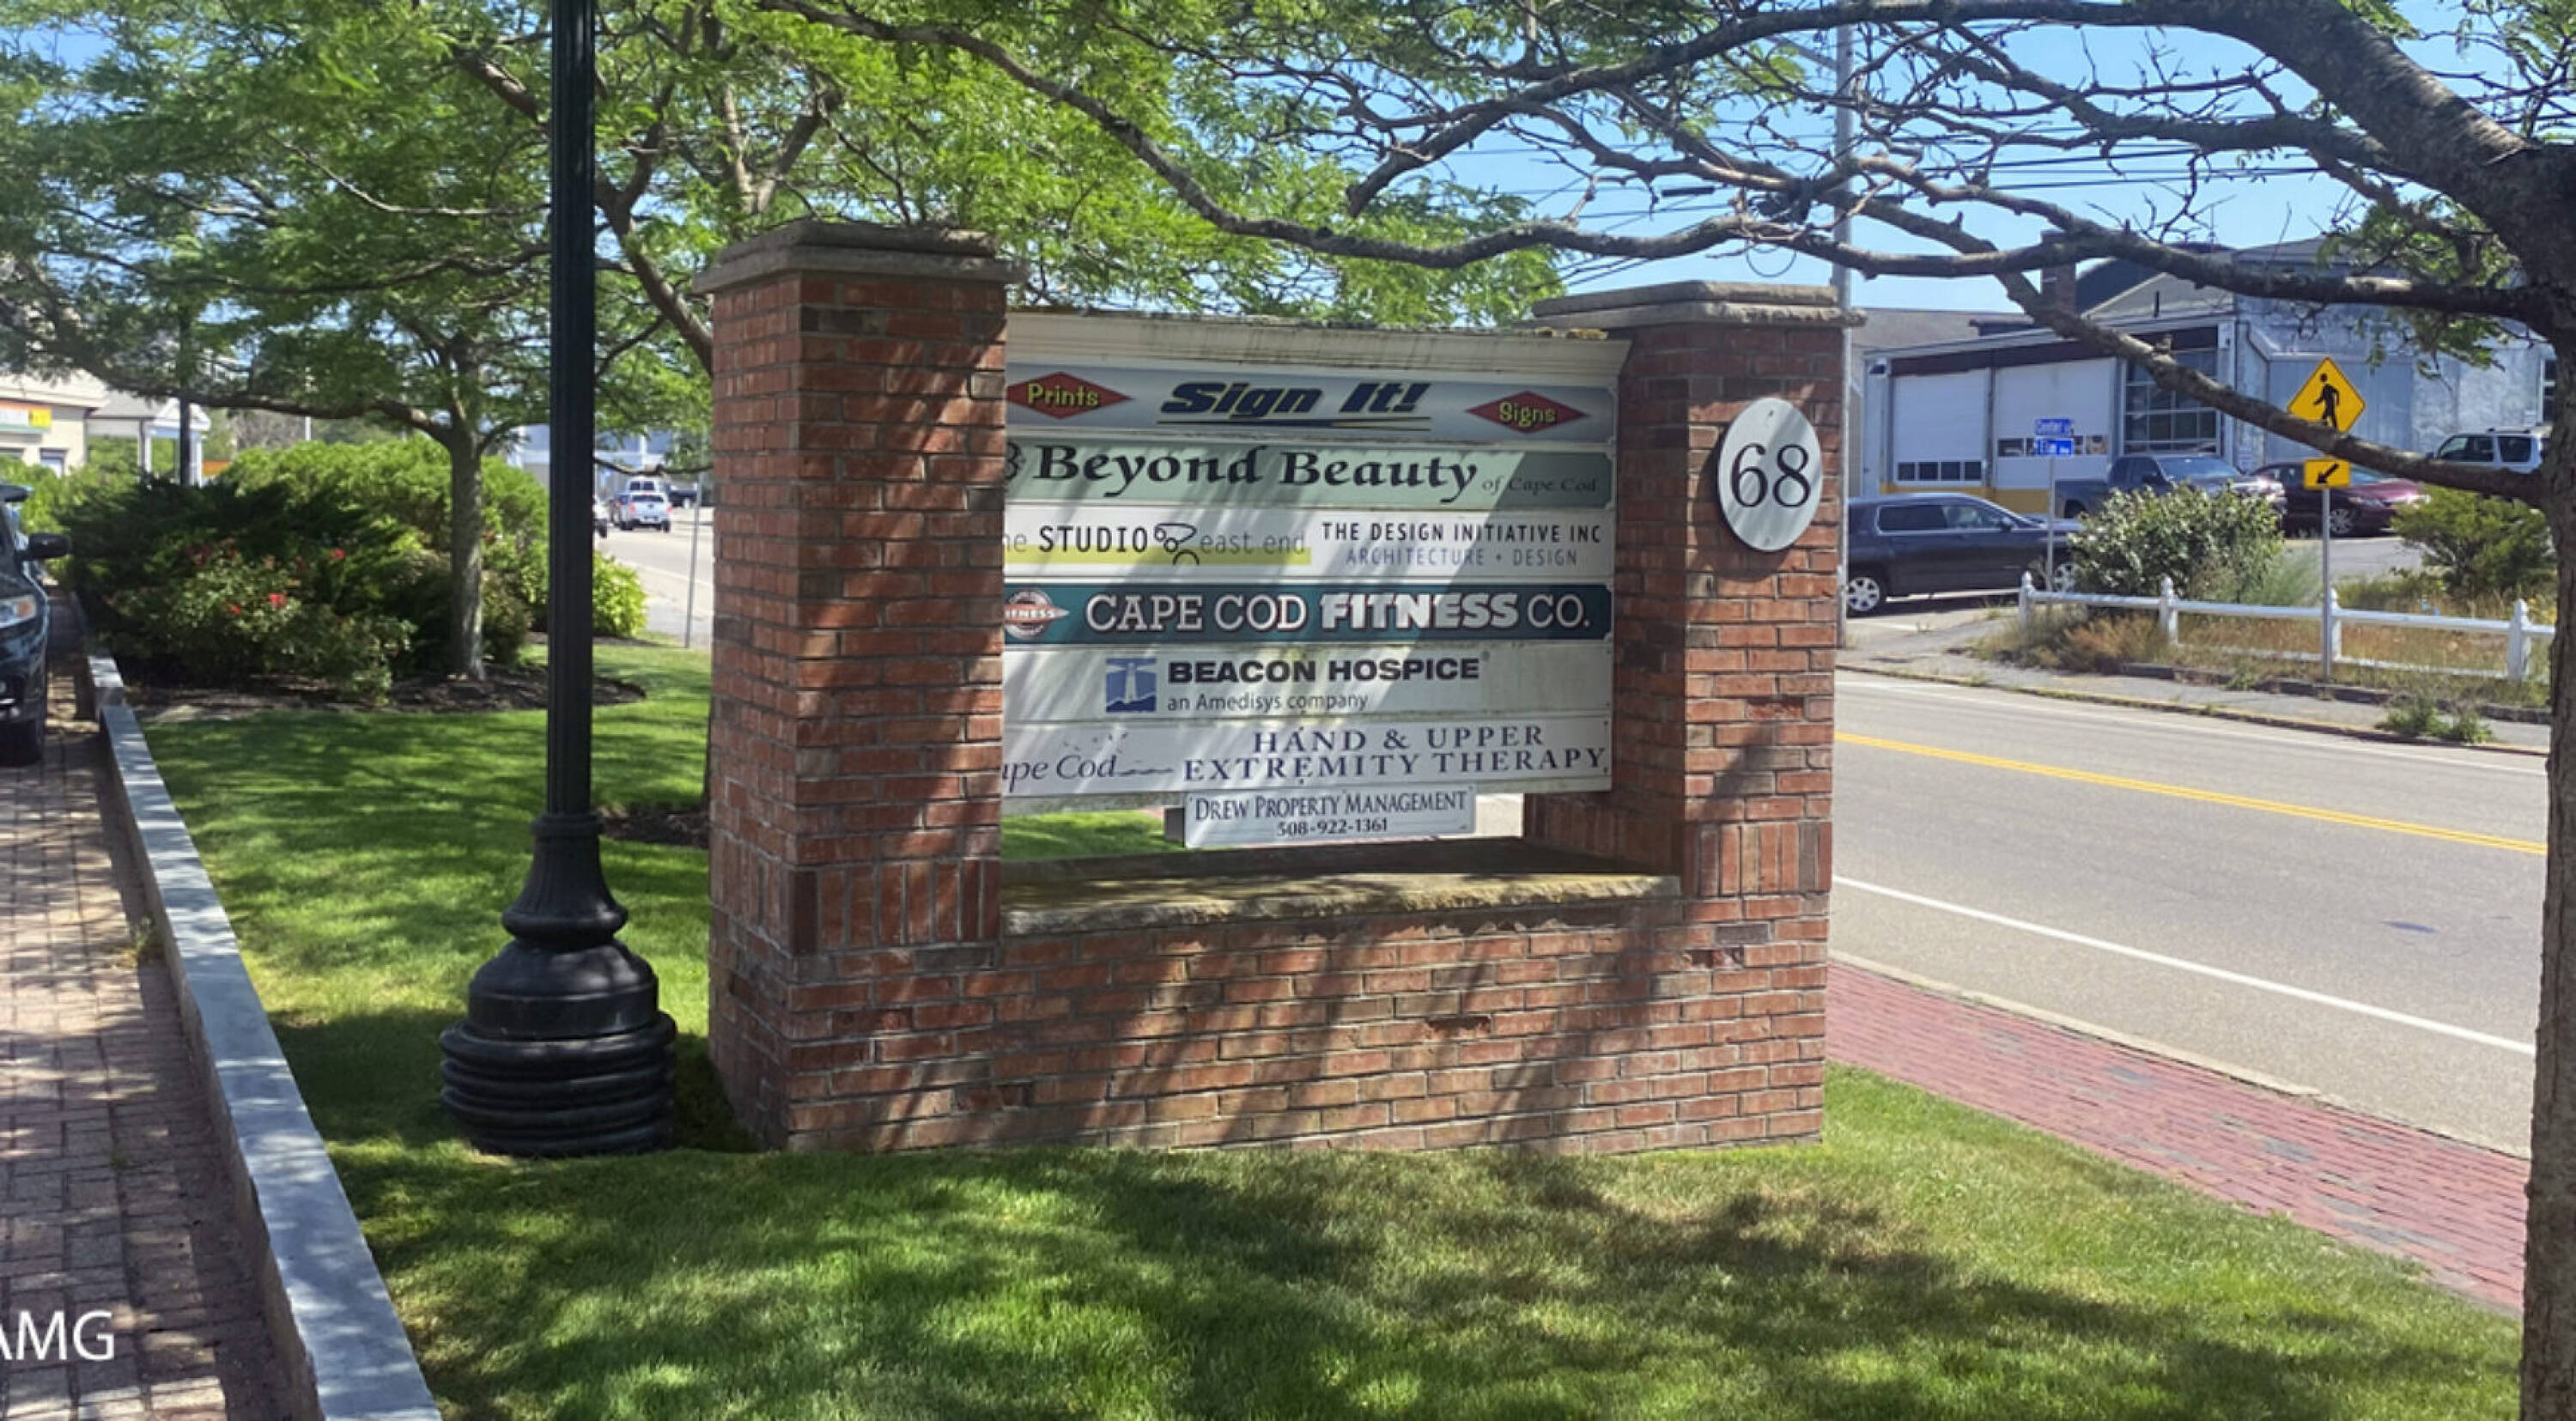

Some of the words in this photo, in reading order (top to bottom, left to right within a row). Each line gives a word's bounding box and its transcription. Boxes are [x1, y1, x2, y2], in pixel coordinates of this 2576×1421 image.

[1026, 383, 1099, 407] Prints
[1160, 380, 1324, 418] Sign
[1338, 383, 1432, 413] It!
[1498, 401, 1557, 427] Signs
[1033, 445, 1269, 498] Beyond
[1279, 451, 1478, 504] Beauty
[1482, 478, 1506, 495] of
[1508, 479, 1554, 495] Cape
[1560, 478, 1598, 492] Cod
[1731, 443, 1812, 508] 68
[1039, 525, 1149, 554] STUDIO
[1199, 532, 1251, 554] east
[1263, 531, 1306, 556] end
[1322, 522, 1360, 541] THE
[1370, 522, 1444, 542] DESIGN
[1454, 523, 1561, 543] INITIATIVE
[1570, 525, 1602, 544] INC
[1346, 547, 1485, 567] ARCHITECTURE
[1512, 548, 1578, 567] DESIGN
[1085, 593, 1202, 631] CAPE
[1214, 594, 1308, 631] COD
[1320, 593, 1520, 630] FITNESS
[1527, 593, 1590, 628] CO.
[1168, 660, 1316, 684] BEACON
[1328, 658, 1479, 681] HOSPICE
[1167, 696, 1191, 711] an
[1195, 692, 1283, 714] Amedisys
[1287, 694, 1369, 714] company
[1254, 730, 1367, 754] HAND
[1383, 729, 1410, 750] &
[1427, 725, 1546, 750] UPPER
[1056, 754, 1118, 780] Cod
[1183, 752, 1420, 782] EXTREMITY
[1431, 747, 1607, 773] THERAPY
[1194, 798, 1249, 822] DREW
[1255, 794, 1340, 818] PROPERTY
[1344, 790, 1467, 815] MANAGEMENT
[1277, 817, 1388, 837] 508-922-1361
